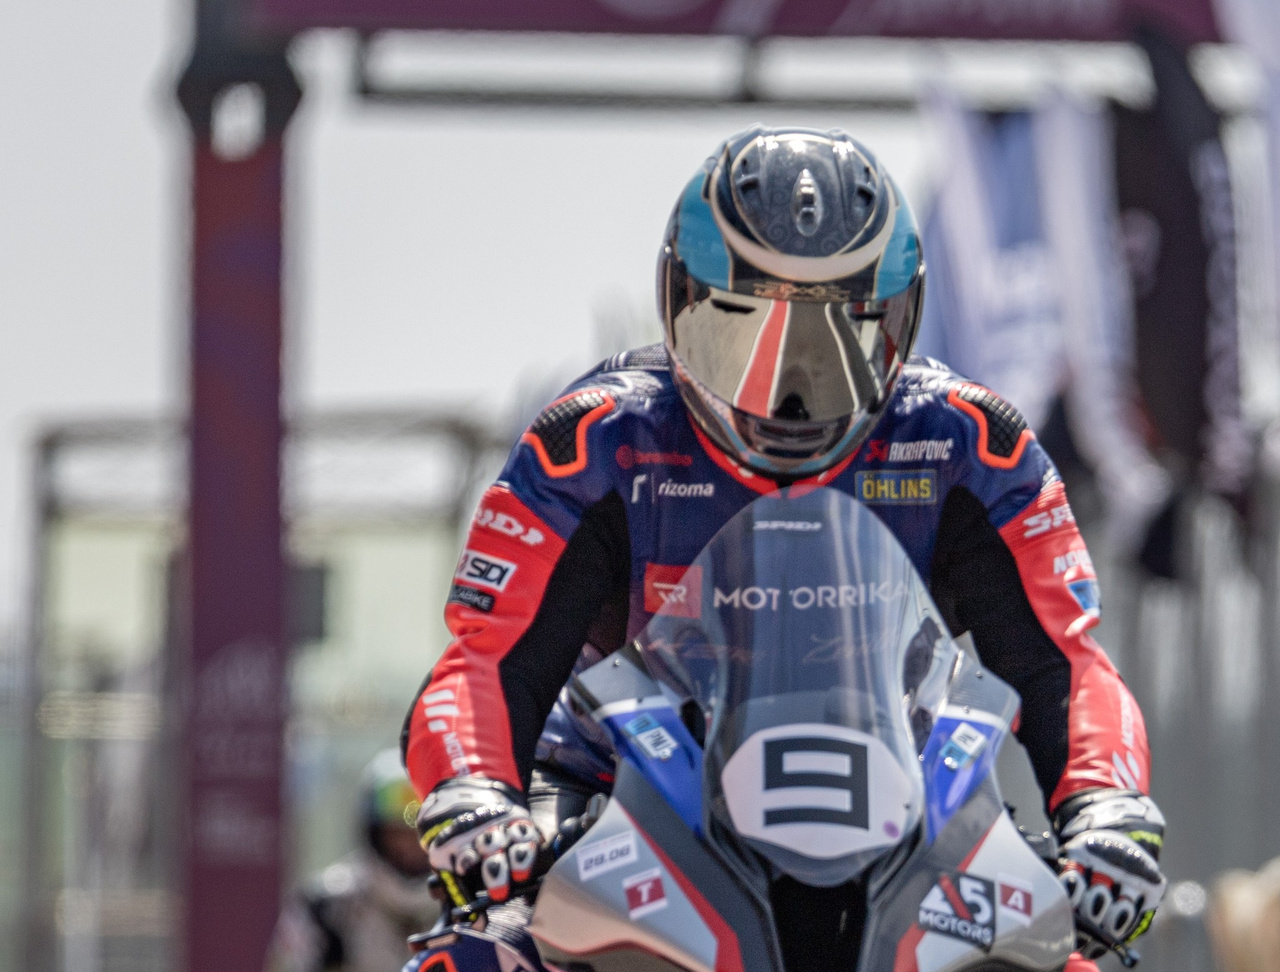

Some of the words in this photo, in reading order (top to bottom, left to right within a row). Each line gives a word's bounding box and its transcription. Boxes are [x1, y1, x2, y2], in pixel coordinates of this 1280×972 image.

[658, 479, 715, 498] rizoma
[762, 737, 870, 832] 9
[1007, 889, 1025, 912] A
[918, 908, 994, 946] MOTORS
